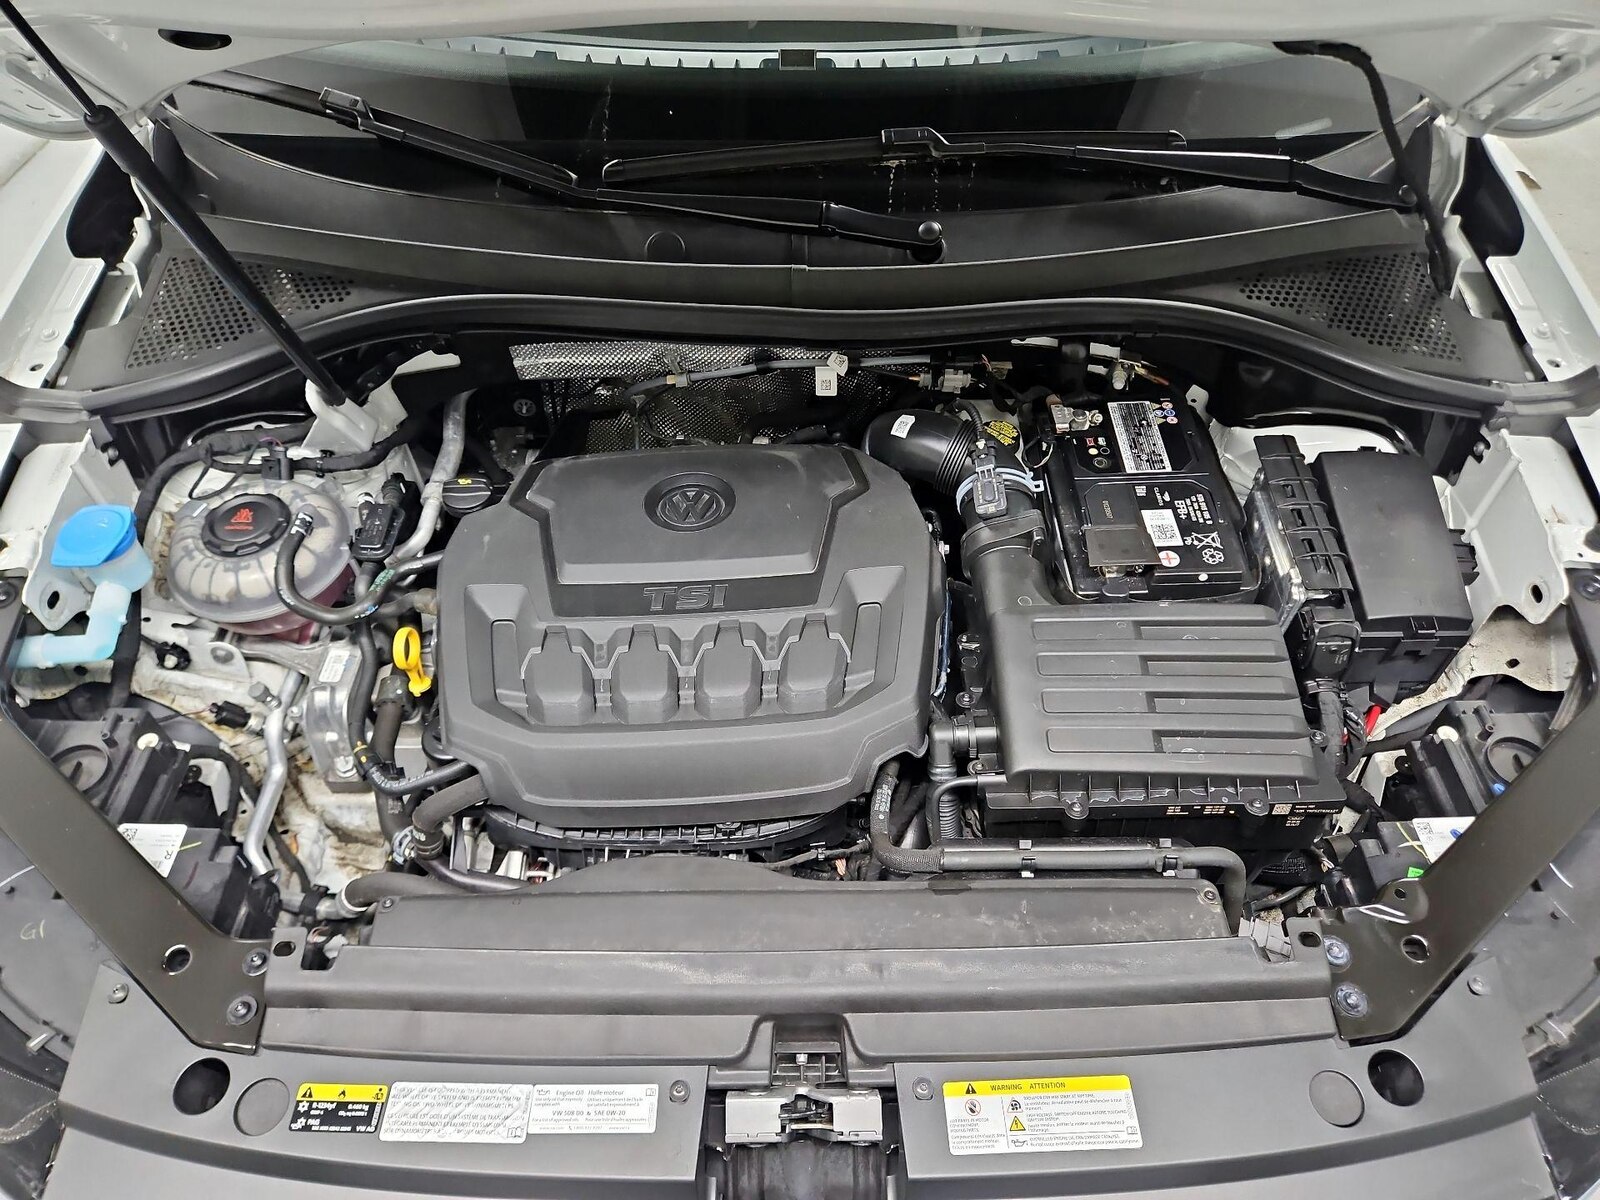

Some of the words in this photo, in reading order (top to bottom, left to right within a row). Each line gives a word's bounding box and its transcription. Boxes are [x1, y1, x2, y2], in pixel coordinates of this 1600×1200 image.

[1154, 487, 1164, 506] CLARIOS
[1174, 500, 1188, 519] EFB+
[643, 584, 728, 611] TSI
[556, 1089, 575, 1097] Engine
[990, 1083, 1023, 1091] WARNING
[1029, 1082, 1066, 1090] ATTENTION
